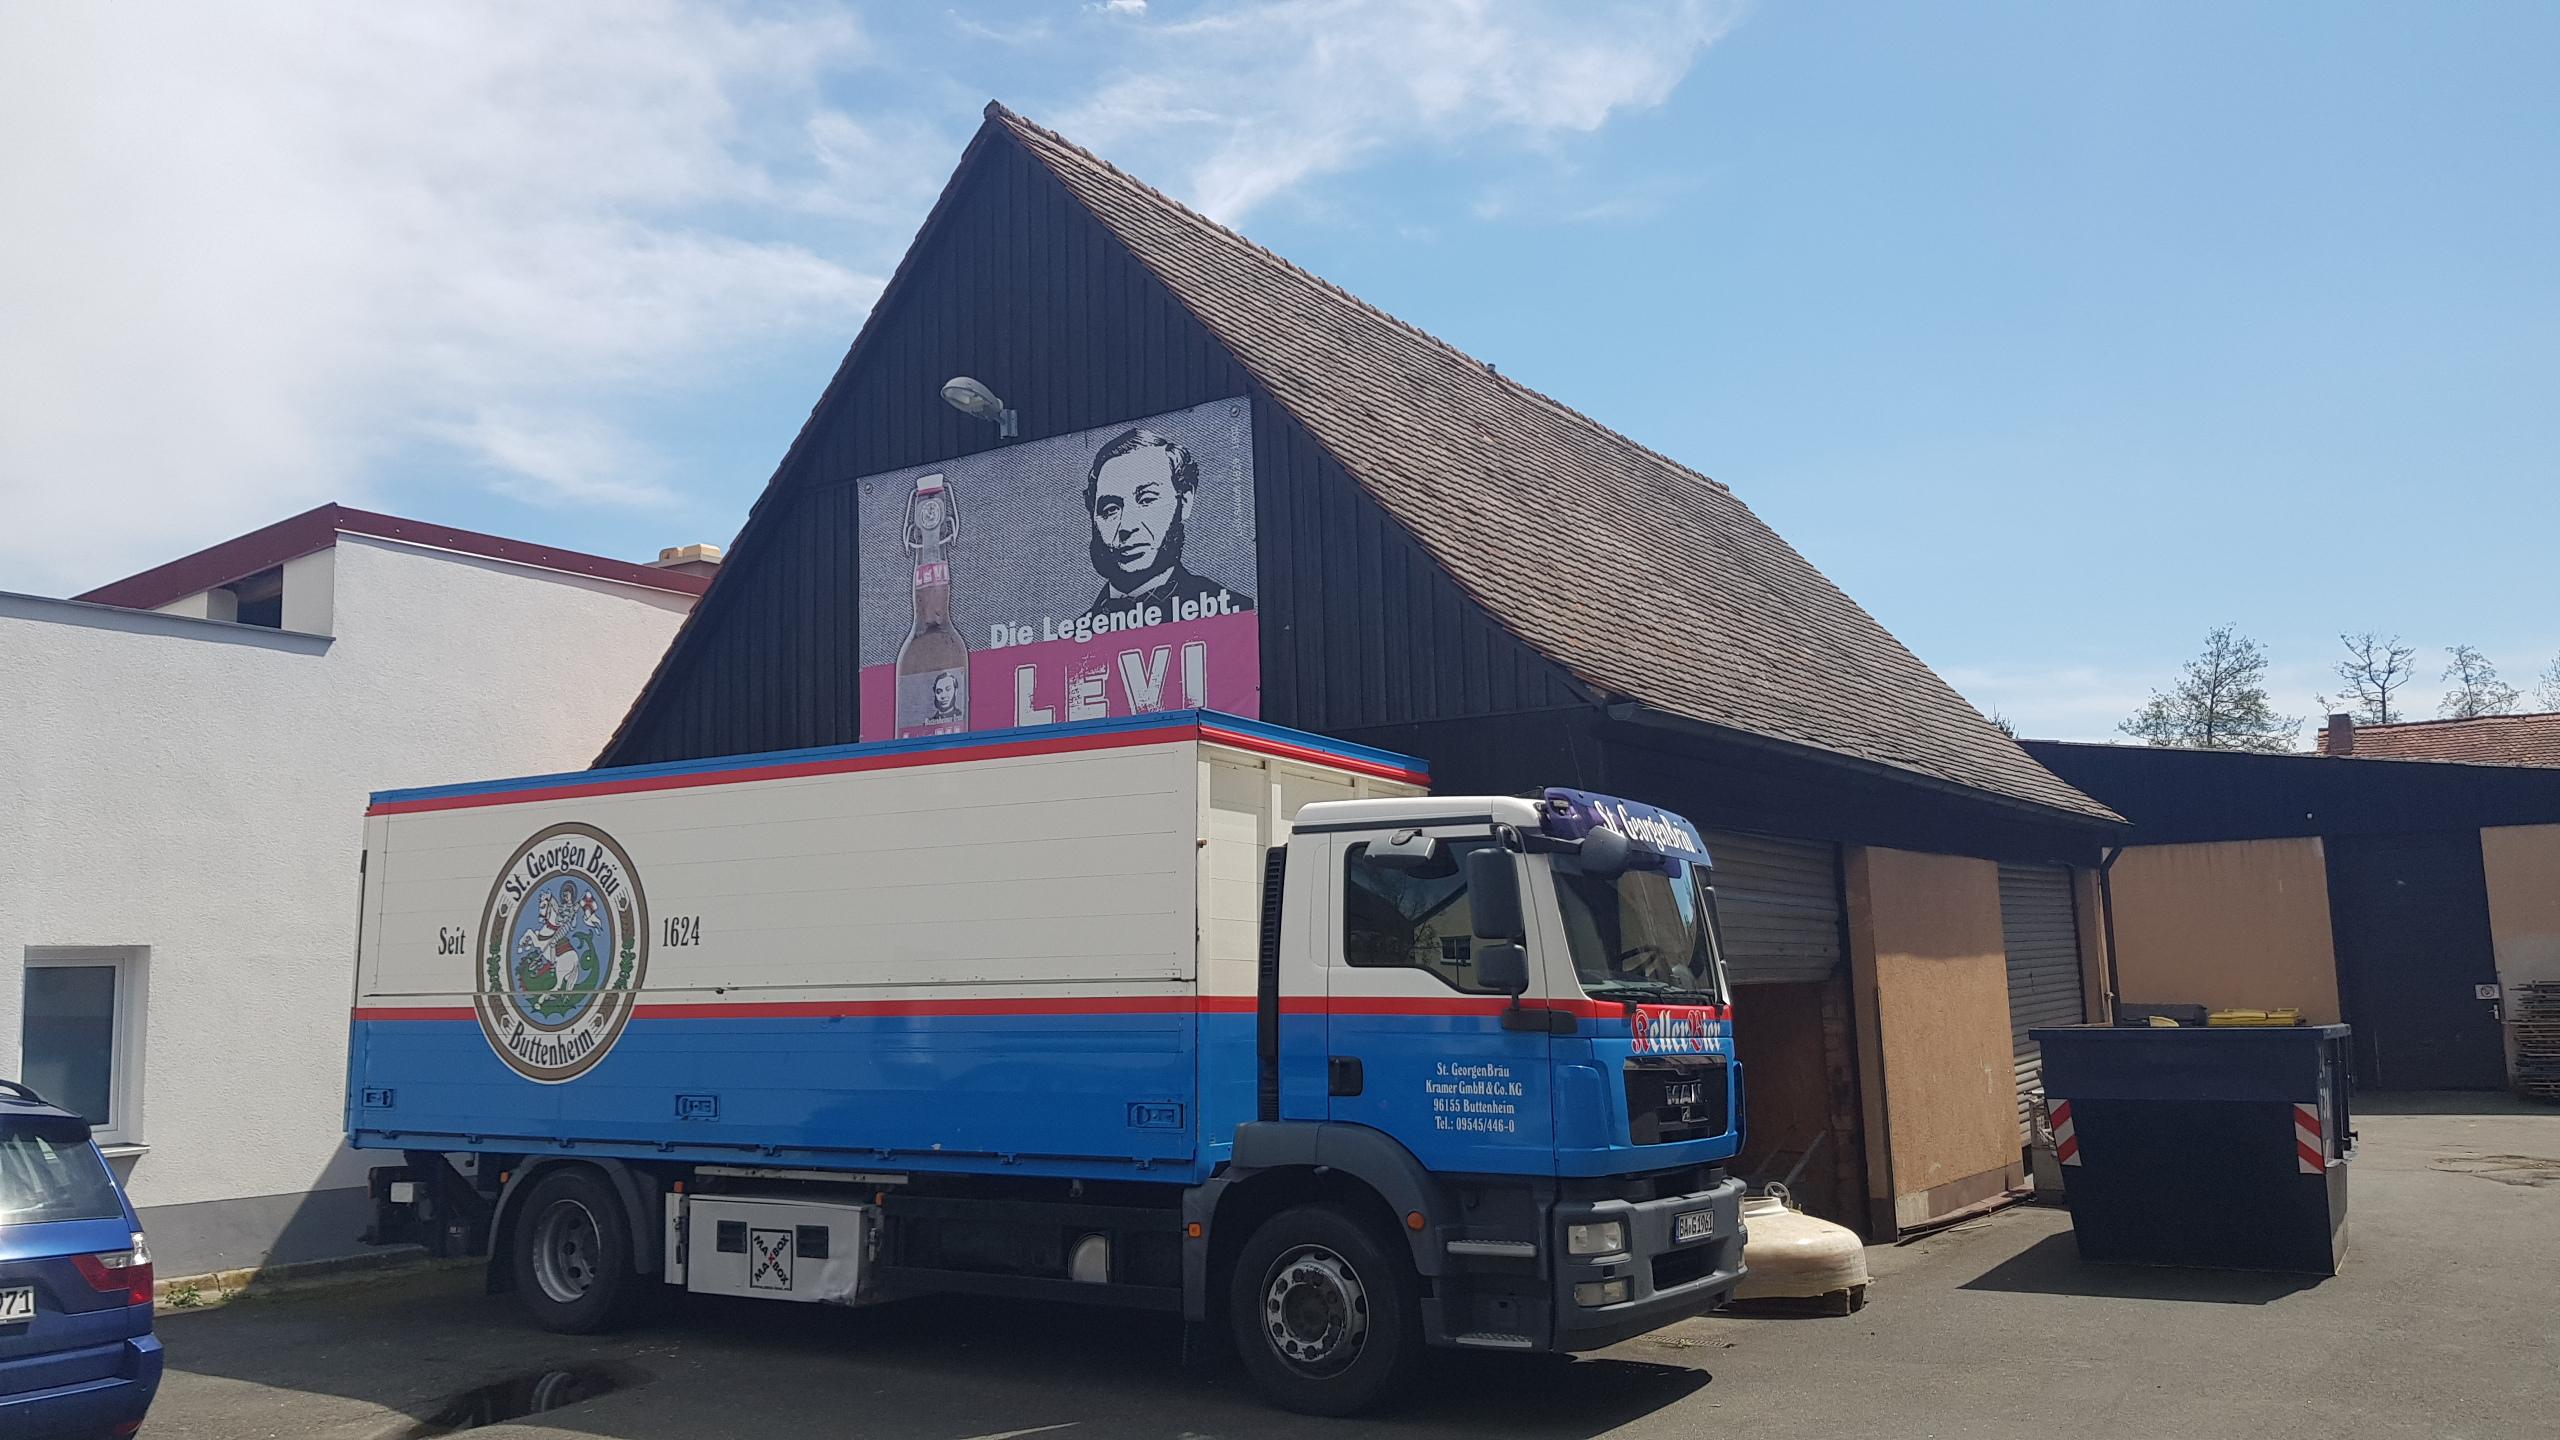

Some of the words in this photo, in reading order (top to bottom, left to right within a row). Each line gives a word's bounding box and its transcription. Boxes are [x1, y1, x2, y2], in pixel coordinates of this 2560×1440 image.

[990, 622, 1034, 650] Die
[1043, 602, 1162, 643] Legende
[1172, 588, 1240, 623] lebt.
[1014, 641, 1207, 727] LEVI
[1594, 800, 1625, 838] St.
[505, 873, 531, 902] St.
[526, 841, 586, 879] Georgen
[586, 845, 620, 897] Bräu
[438, 926, 466, 955] Seit
[662, 916, 700, 947] 1624
[508, 1021, 595, 1066] Buttenheim
[1436, 1061, 1449, 1076] St.
[1451, 1062, 1510, 1079] GeorgenBräu
[1425, 1079, 1457, 1094] Kramer
[1458, 1080, 1485, 1095] GmbH
[1485, 1081, 1494, 1096] &
[1493, 1082, 1508, 1096] Co.
[1508, 1082, 1522, 1096] KG
[1433, 1098, 1461, 1112] 96155
[1463, 1099, 1515, 1114] Buttenheim
[1434, 1116, 1454, 1130] Tel.:
[1456, 1117, 1515, 1133] 09545/446-0
[0, 1290, 31, 1315] 71
